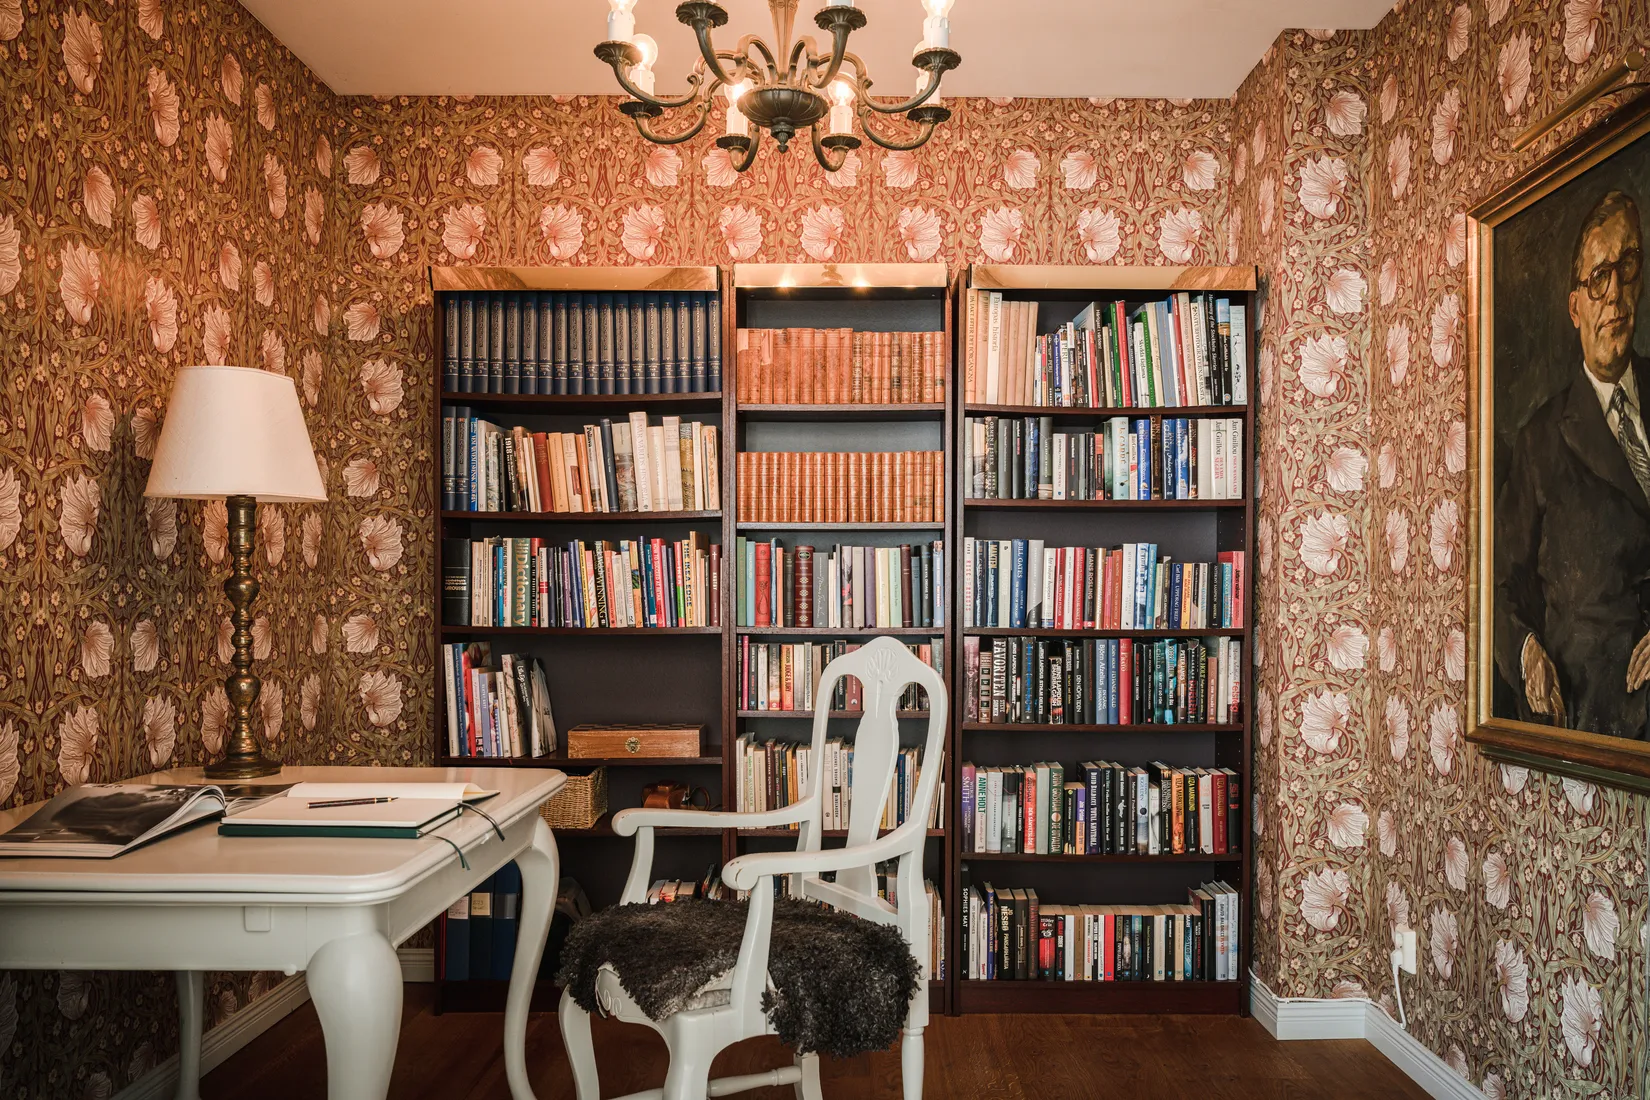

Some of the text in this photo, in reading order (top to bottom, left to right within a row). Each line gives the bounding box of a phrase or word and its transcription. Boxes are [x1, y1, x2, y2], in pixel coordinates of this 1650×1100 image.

[992, 296, 1000, 324] Europas
[504, 437, 512, 454] 1918
[513, 553, 529, 626] Dictionary
[596, 576, 606, 618] WINNING
[993, 640, 1006, 697] FAVORITEN
[1052, 772, 1061, 786] JOHN
[1216, 778, 1224, 788] LIZA
[978, 776, 986, 814] ANNE HOLT
[1052, 788, 1061, 812] GRISHAM
